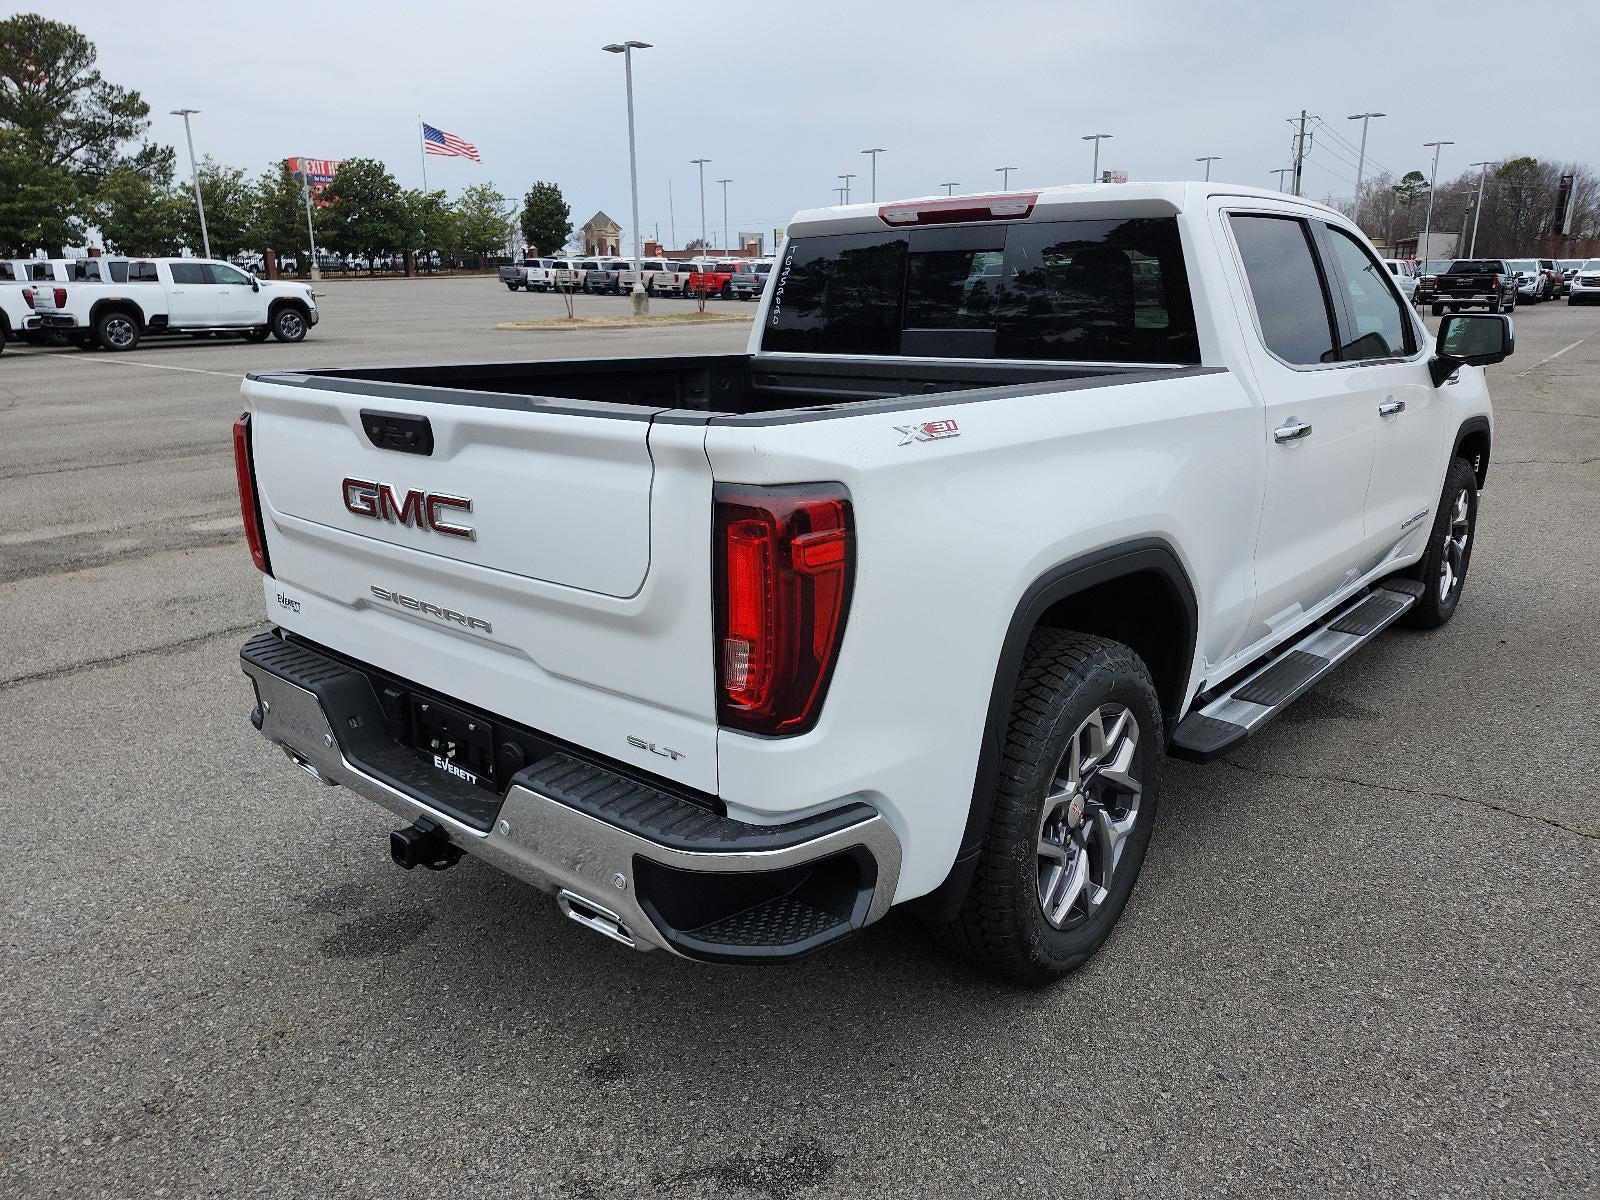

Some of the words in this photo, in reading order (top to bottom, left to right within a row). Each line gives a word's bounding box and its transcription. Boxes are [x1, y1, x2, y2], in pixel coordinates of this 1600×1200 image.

[306, 159, 326, 174] EXIT
[342, 476, 477, 542] GMC
[370, 585, 493, 634] SIERRA
[626, 735, 686, 761] SLT
[433, 754, 477, 785] EVERETT
